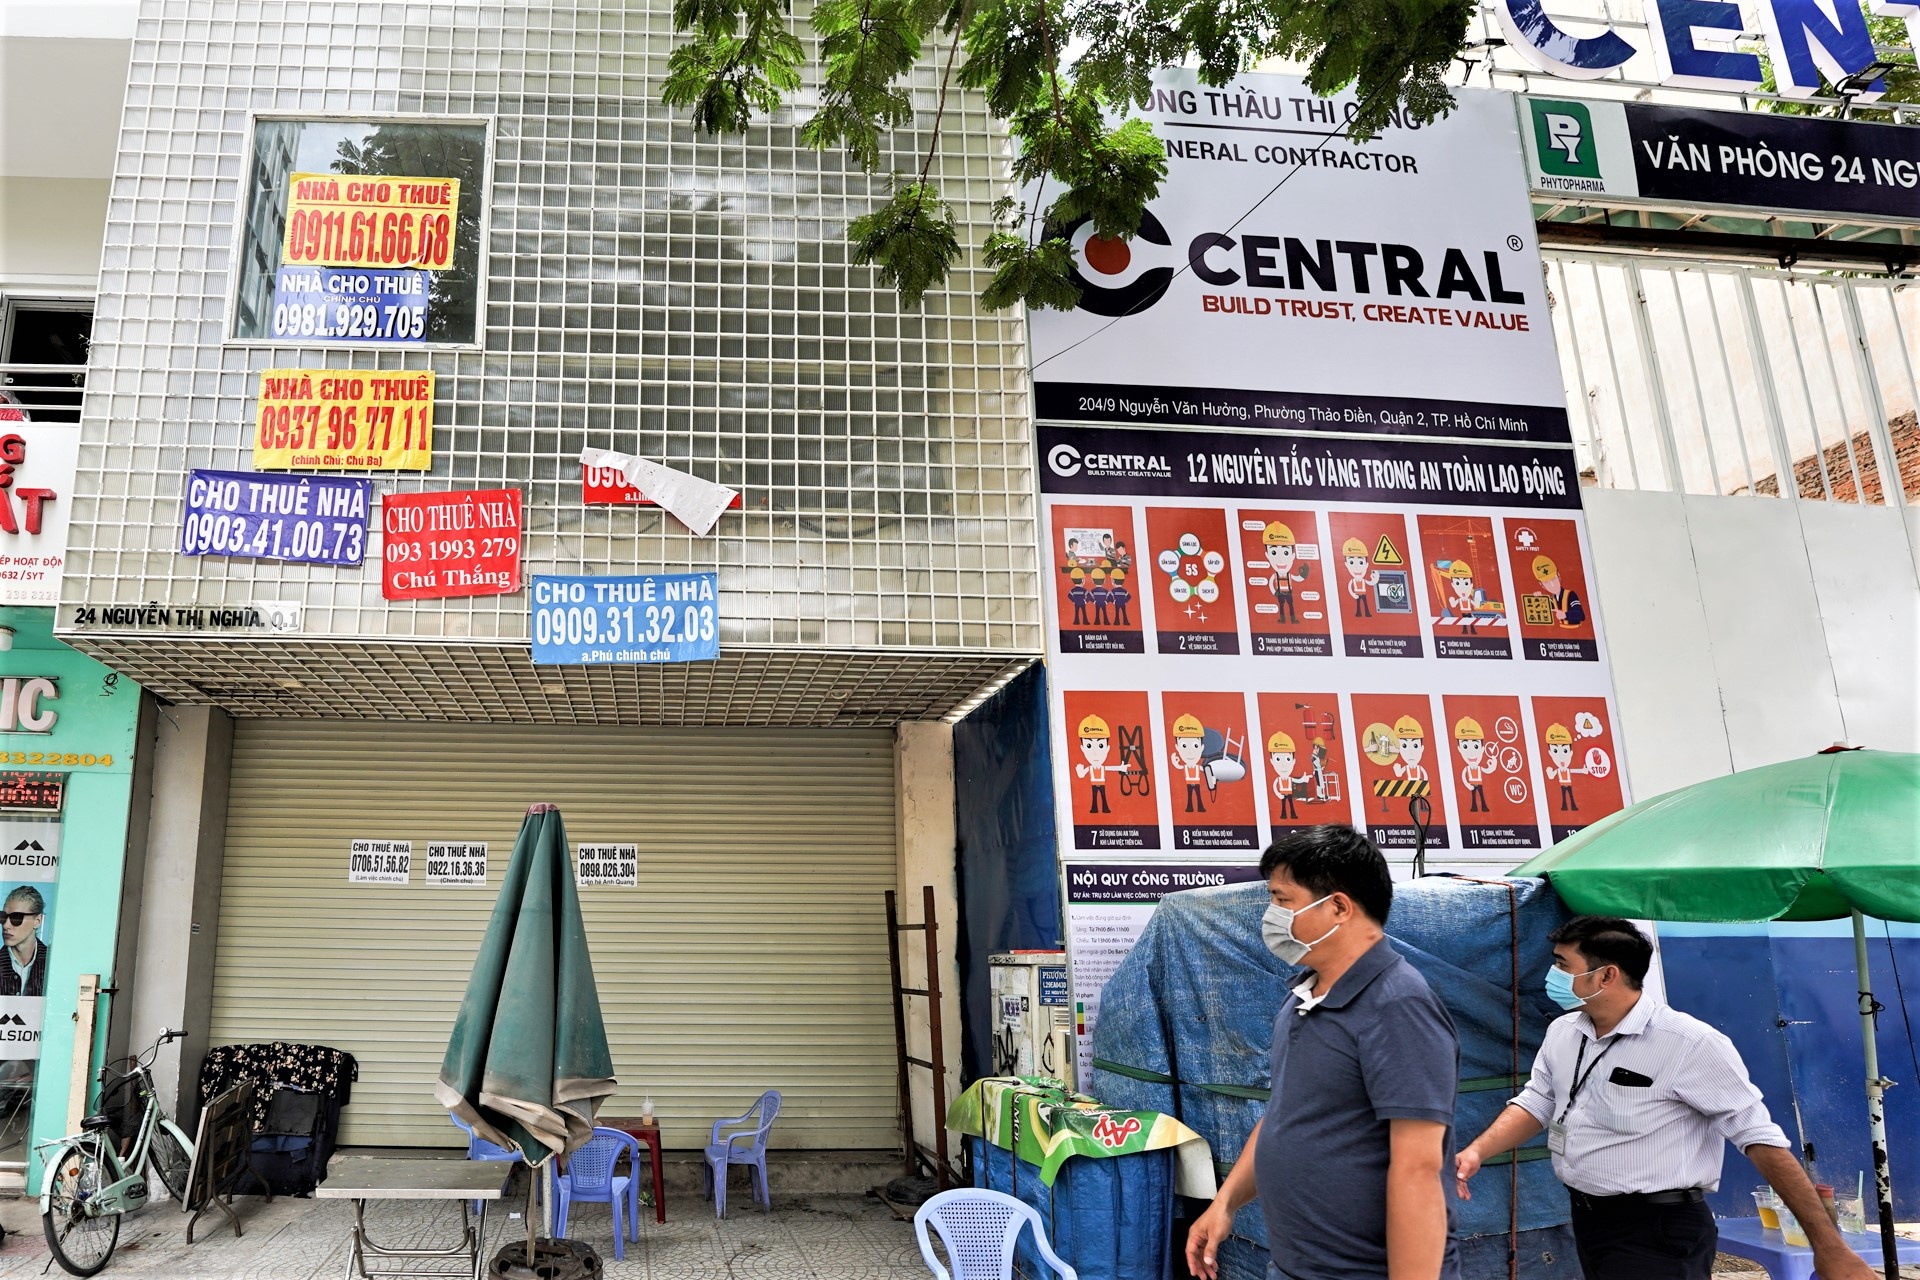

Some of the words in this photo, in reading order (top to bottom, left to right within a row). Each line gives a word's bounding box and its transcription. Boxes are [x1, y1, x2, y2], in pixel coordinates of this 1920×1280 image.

[1204, 86, 1283, 120] THẦU
[1289, 98, 1336, 124] THI
[1165, 139, 1248, 163] NERAL
[1254, 145, 1418, 174] CONTRACTOR
[1642, 135, 1711, 172] VĂN
[1719, 141, 1825, 181] PHÒNG
[1831, 155, 1865, 184] 24
[1872, 158, 1920, 188] NG
[297, 179, 339, 200] NHÀ
[347, 182, 391, 203] CHO
[398, 183, 451, 205] THUÊ
[1541, 177, 1606, 193] PHYTOPHARMA
[1188, 232, 1526, 305] CENTRAL
[282, 271, 324, 293] NHÀ
[328, 275, 370, 294] CHO
[375, 273, 423, 295] THUÊ
[274, 304, 426, 338] 0981.929.705
[1203, 295, 1271, 316] BUILD
[1276, 299, 1356, 322] TRUST,
[1363, 304, 1452, 326] CREATE
[1455, 310, 1530, 332] VALUE
[264, 375, 312, 400] NHÀ
[320, 378, 364, 400] CHO
[370, 375, 429, 401] THUÊ
[1079, 397, 1116, 412] 204/9
[1119, 398, 1169, 417] Nguyễn
[1172, 401, 1199, 415] Văn
[1202, 402, 1251, 420] Hưởng,
[1254, 405, 1306, 423] Phường
[1308, 407, 1340, 422] Thảo
[1344, 407, 1377, 426] Điền,
[1380, 410, 1414, 428] Quận
[1417, 412, 1429, 428] 2,
[1431, 413, 1450, 428] TP.
[1454, 412, 1472, 430] Hồ
[1474, 415, 1496, 431] Chí
[1499, 417, 1528, 432] Minh
[260, 406, 321, 450] 0937
[327, 406, 357, 450] 96
[366, 406, 395, 450] 77
[404, 406, 427, 450] 11
[1084, 454, 1171, 471] CENTRAL
[1187, 453, 1208, 483] 12
[1212, 448, 1277, 485] NGUYÊN
[1279, 444, 1313, 486] TẮC
[1315, 450, 1361, 488] VÀNG
[1361, 459, 1417, 490] TRONG
[1420, 461, 1441, 491] AN
[1443, 455, 1487, 492] TOÀN
[1488, 464, 1519, 494] LAO
[1522, 458, 1567, 501] ĐỘNG
[189, 479, 240, 511] CHO
[248, 478, 310, 515] THUÊ
[316, 481, 365, 518] NHÀ
[385, 506, 424, 534] CHO
[427, 495, 475, 531] THUÊ
[479, 493, 517, 529] NHÀ
[185, 512, 363, 562] 0903.41.00.73
[386, 541, 422, 564] 093
[428, 538, 476, 561] 1993
[481, 537, 517, 558] 279
[13, 557, 39, 569] HOẠT
[1185, 563, 1199, 577] 5S
[392, 570, 437, 590] Chú
[442, 563, 511, 589] Thắng
[535, 582, 586, 605] CHO
[594, 578, 656, 603] THUÊ
[666, 576, 714, 601] NHÀ
[75, 607, 96, 625] 24
[101, 601, 170, 625] NGUYỄN
[176, 609, 204, 630] THỊ
[209, 607, 265, 628] NGHĨA.
[271, 611, 298, 630] Q.1
[536, 605, 714, 645] 0909.31.32.03
[1078, 634, 1083, 649] 1
[1179, 636, 1186, 650] 2
[1258, 636, 1265, 651] 3
[1360, 639, 1366, 653] 4
[1440, 640, 1447, 655] 5
[1540, 642, 1547, 657] 6
[581, 649, 613, 663] a.Phú
[616, 649, 647, 661] chính
[650, 648, 671, 661] chủ
[1591, 766, 1607, 775] STOP
[1510, 784, 1522, 796] WC
[1091, 830, 1097, 846] 7
[1183, 830, 1190, 845] 8
[1374, 829, 1386, 845] 10
[1470, 829, 1479, 845] 11
[353, 843, 369, 852] CHO
[371, 842, 391, 853] THUÊ
[393, 842, 410, 853] NHÀ
[429, 847, 444, 857] CHO
[447, 844, 467, 857] THUÊ
[469, 845, 485, 857] NHÀ
[580, 848, 595, 860] CHO
[598, 846, 617, 860] THUÊ
[620, 846, 636, 860] NHÀ
[351, 854, 409, 873] 0706.51.56.82
[428, 861, 485, 876] 0922.16.36.36
[580, 863, 635, 877] 0898.026.304
[1073, 870, 1097, 888] NỘI
[1101, 873, 1128, 887] QUY
[1132, 870, 1170, 886] CÔNG
[1173, 870, 1225, 886] TRƯỜNG
[1135, 891, 1149, 899] CÔNG
